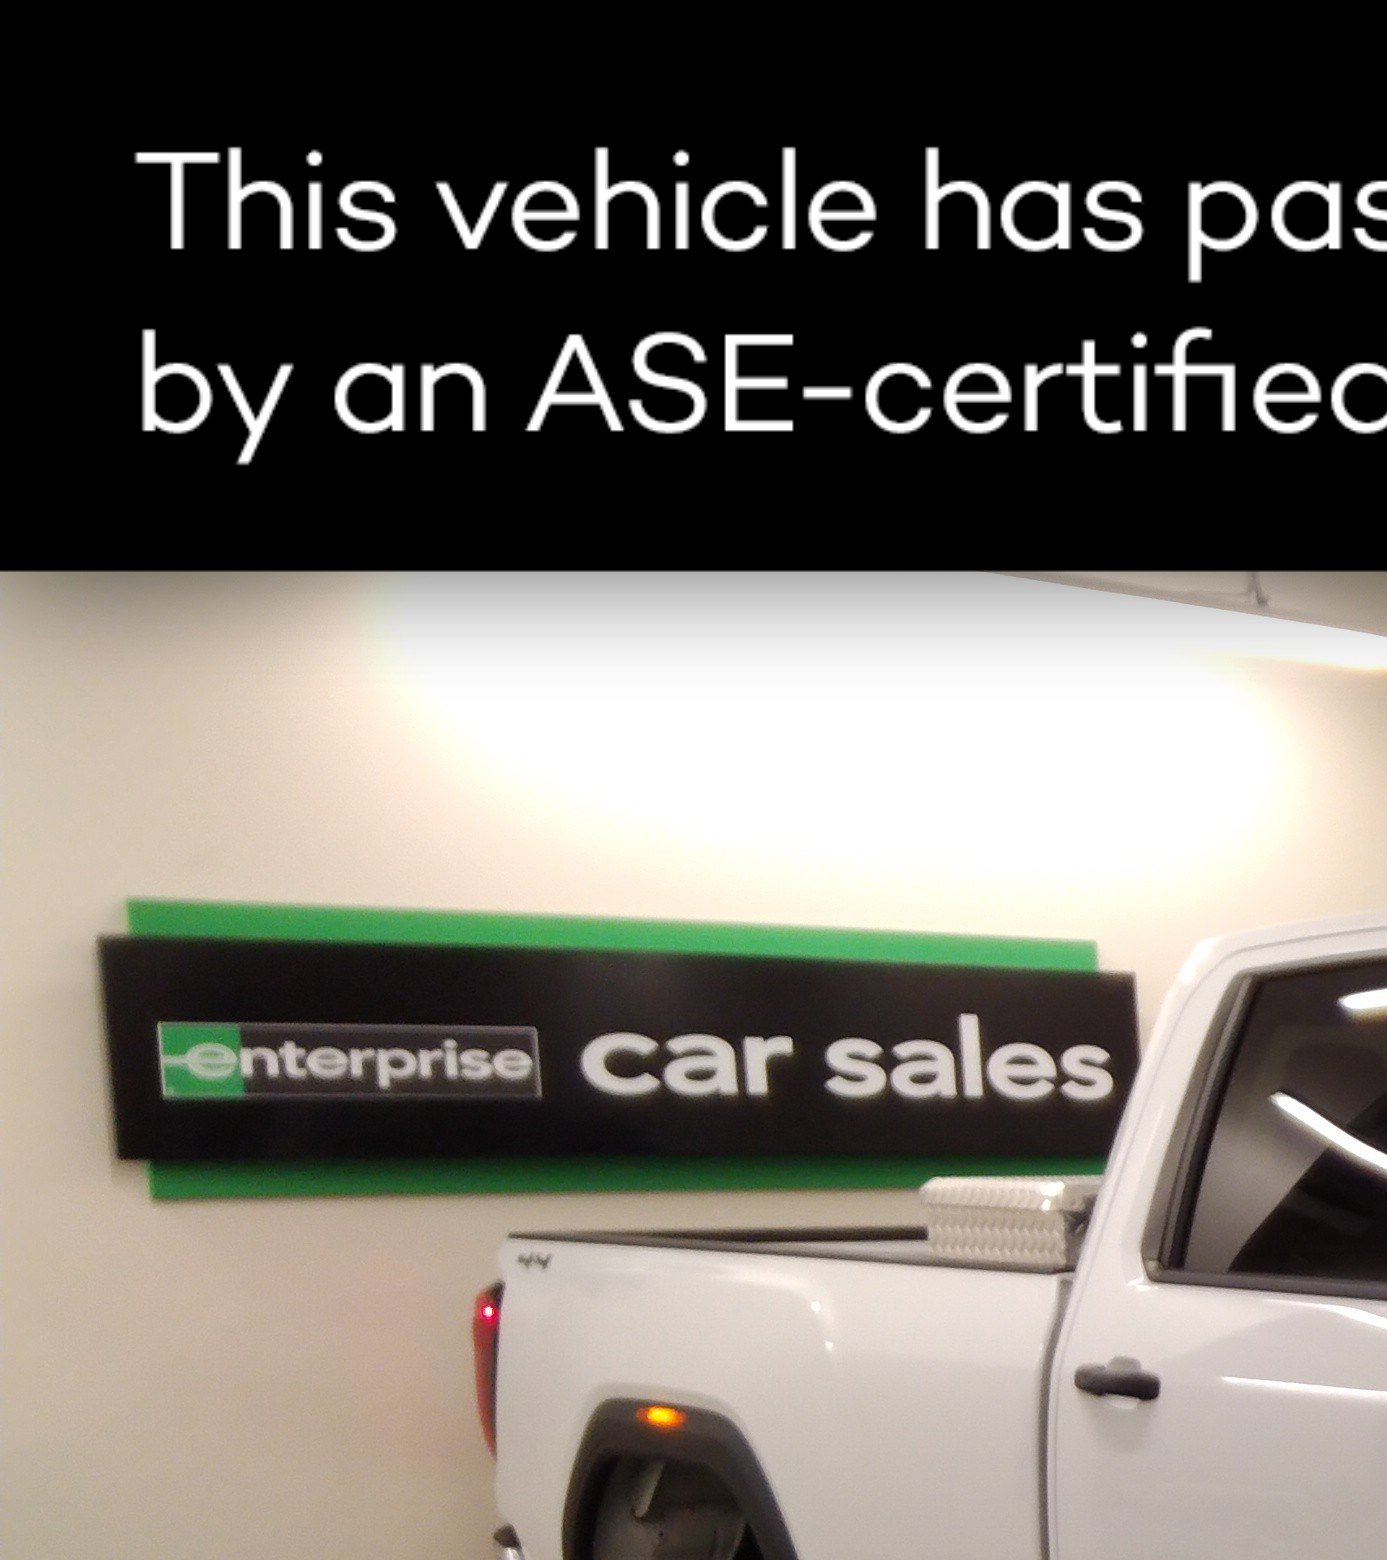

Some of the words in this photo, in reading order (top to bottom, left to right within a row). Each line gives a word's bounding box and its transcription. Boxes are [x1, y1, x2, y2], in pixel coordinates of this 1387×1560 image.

[163, 1038, 534, 1091] enterprise
[580, 1031, 795, 1097] car
[823, 1012, 1115, 1100] sales
